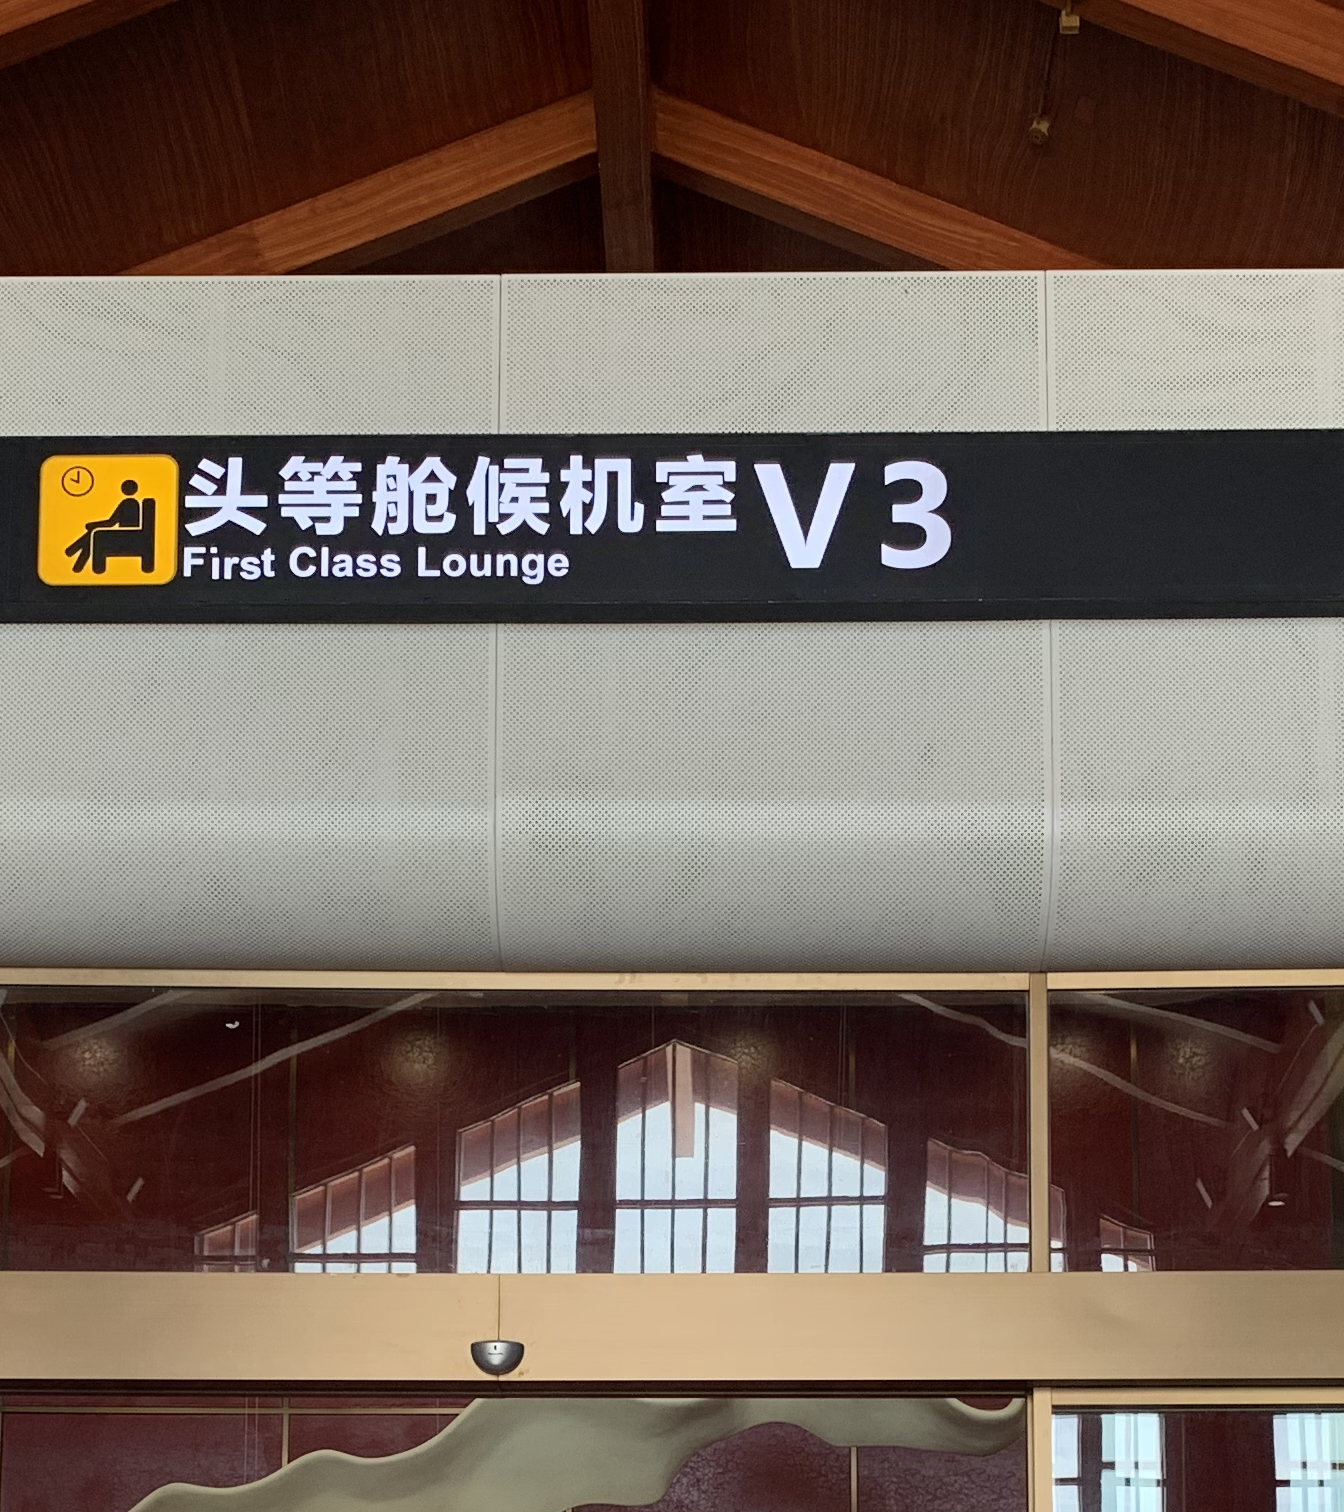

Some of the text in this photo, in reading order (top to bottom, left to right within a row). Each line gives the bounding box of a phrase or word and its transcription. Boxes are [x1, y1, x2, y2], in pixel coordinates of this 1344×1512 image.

[184, 453, 738, 535] 头等舱候机室
[183, 545, 570, 586] First Class Lounge
